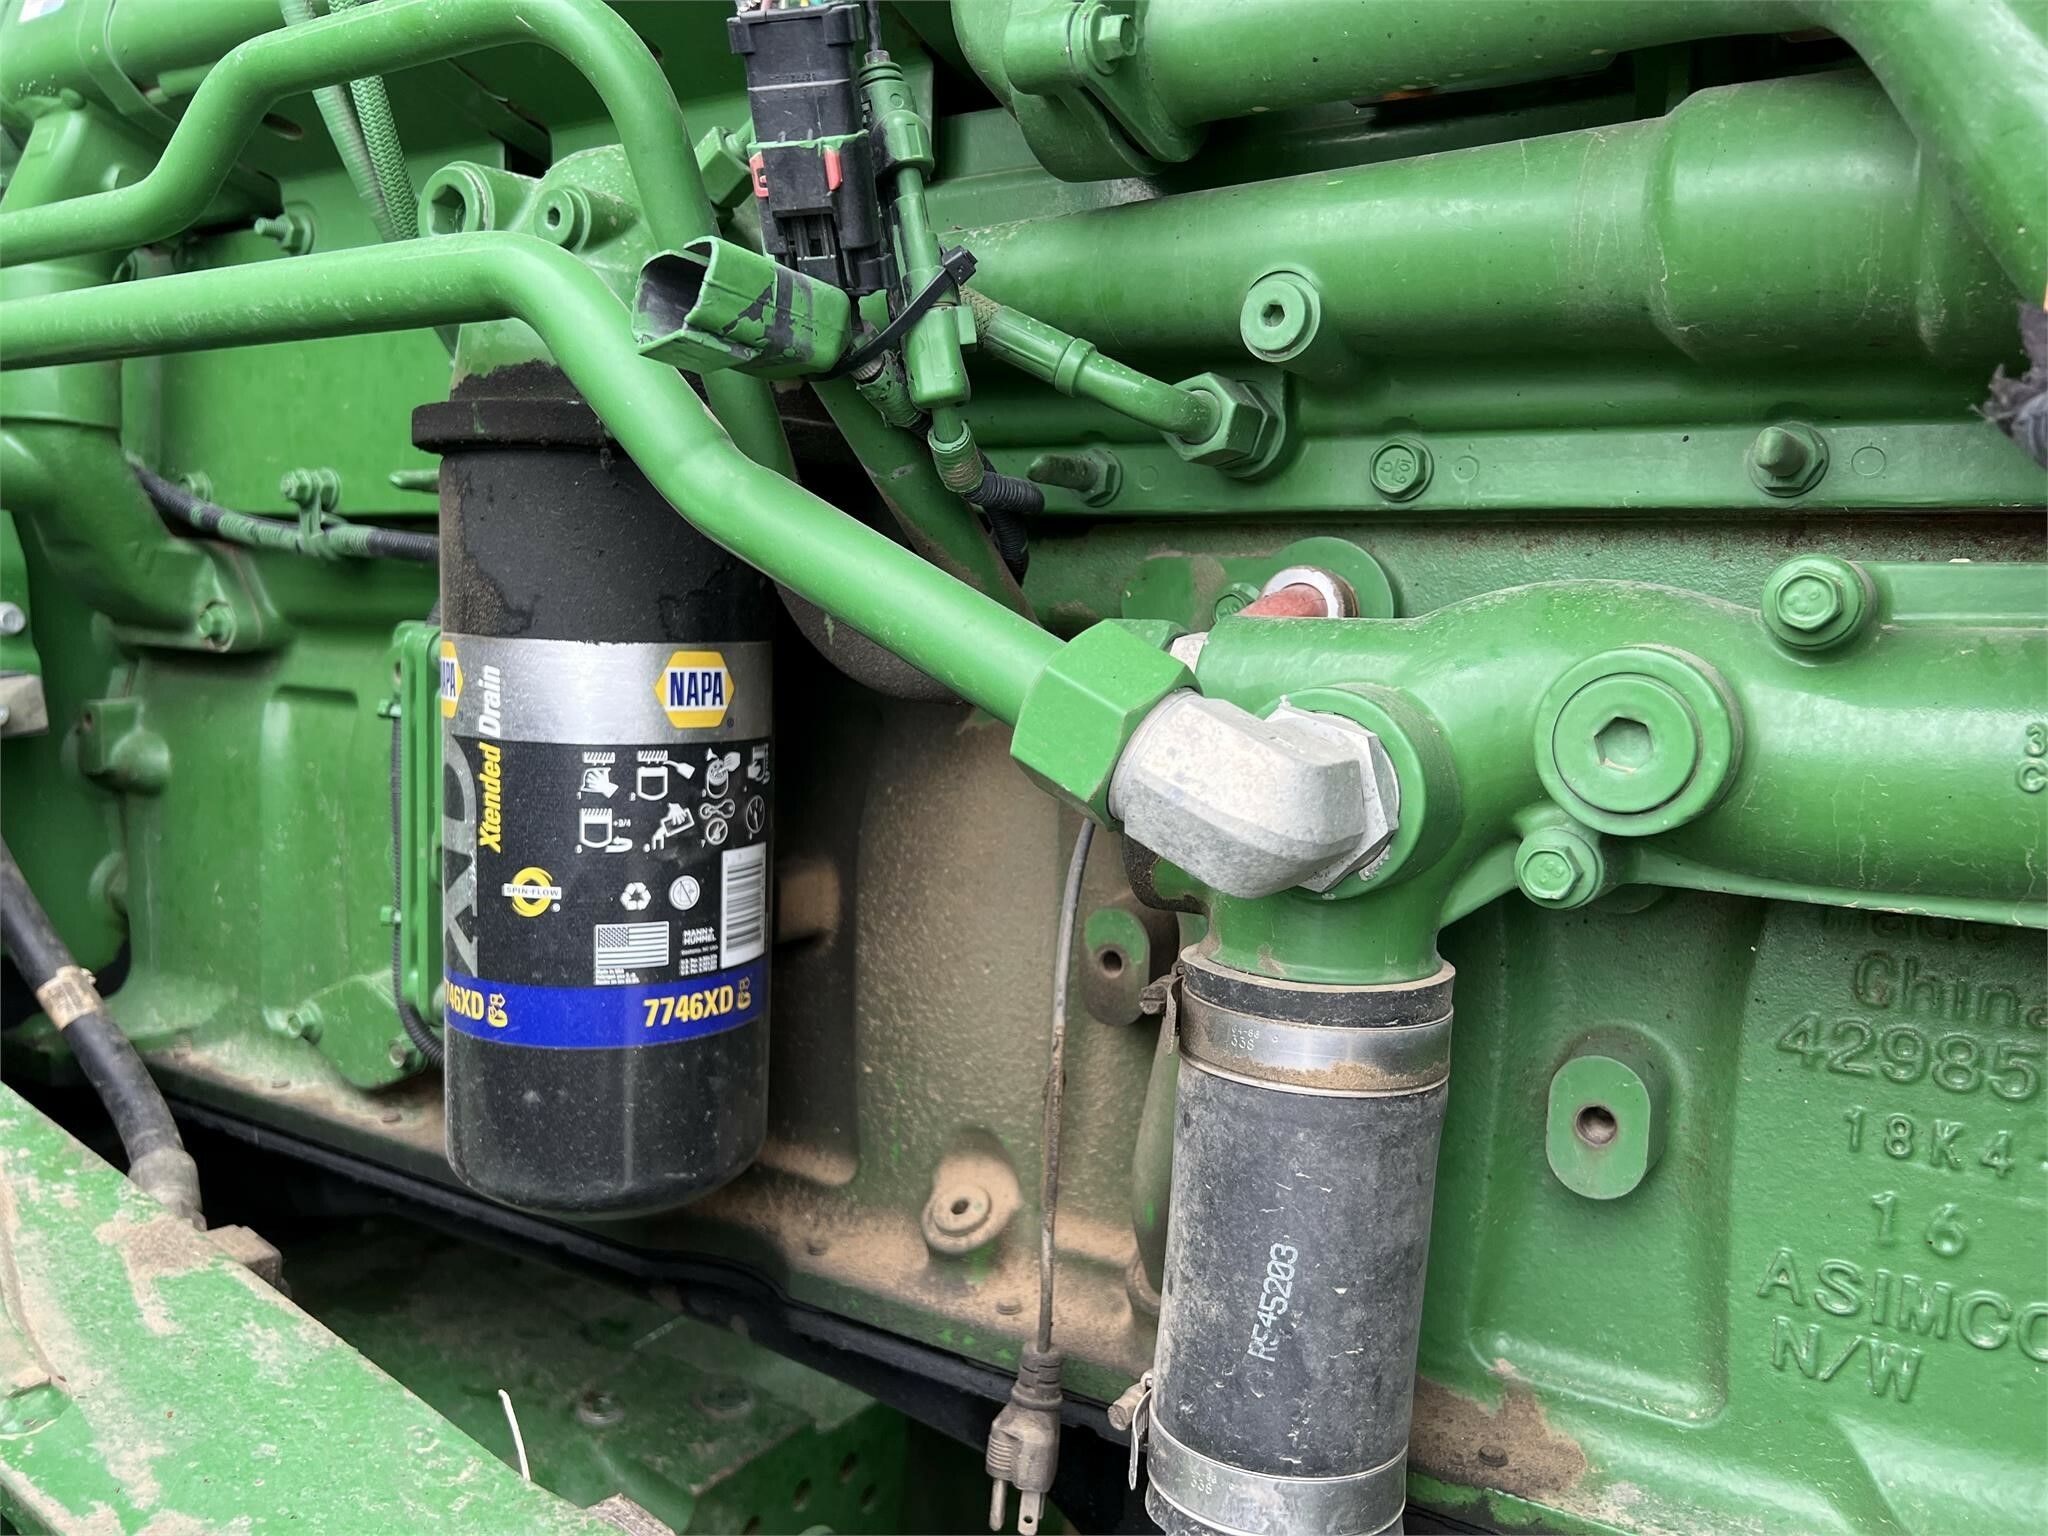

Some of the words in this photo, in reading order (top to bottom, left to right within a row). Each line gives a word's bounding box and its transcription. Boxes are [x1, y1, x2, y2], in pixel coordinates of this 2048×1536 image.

[478, 664, 501, 739] Drain
[670, 671, 725, 707] NAPA
[478, 742, 502, 853] Xtended
[643, 984, 734, 1028] 7746XD
[1776, 1013, 2041, 1103] 42985
[1770, 1316, 1923, 1403] N/W
